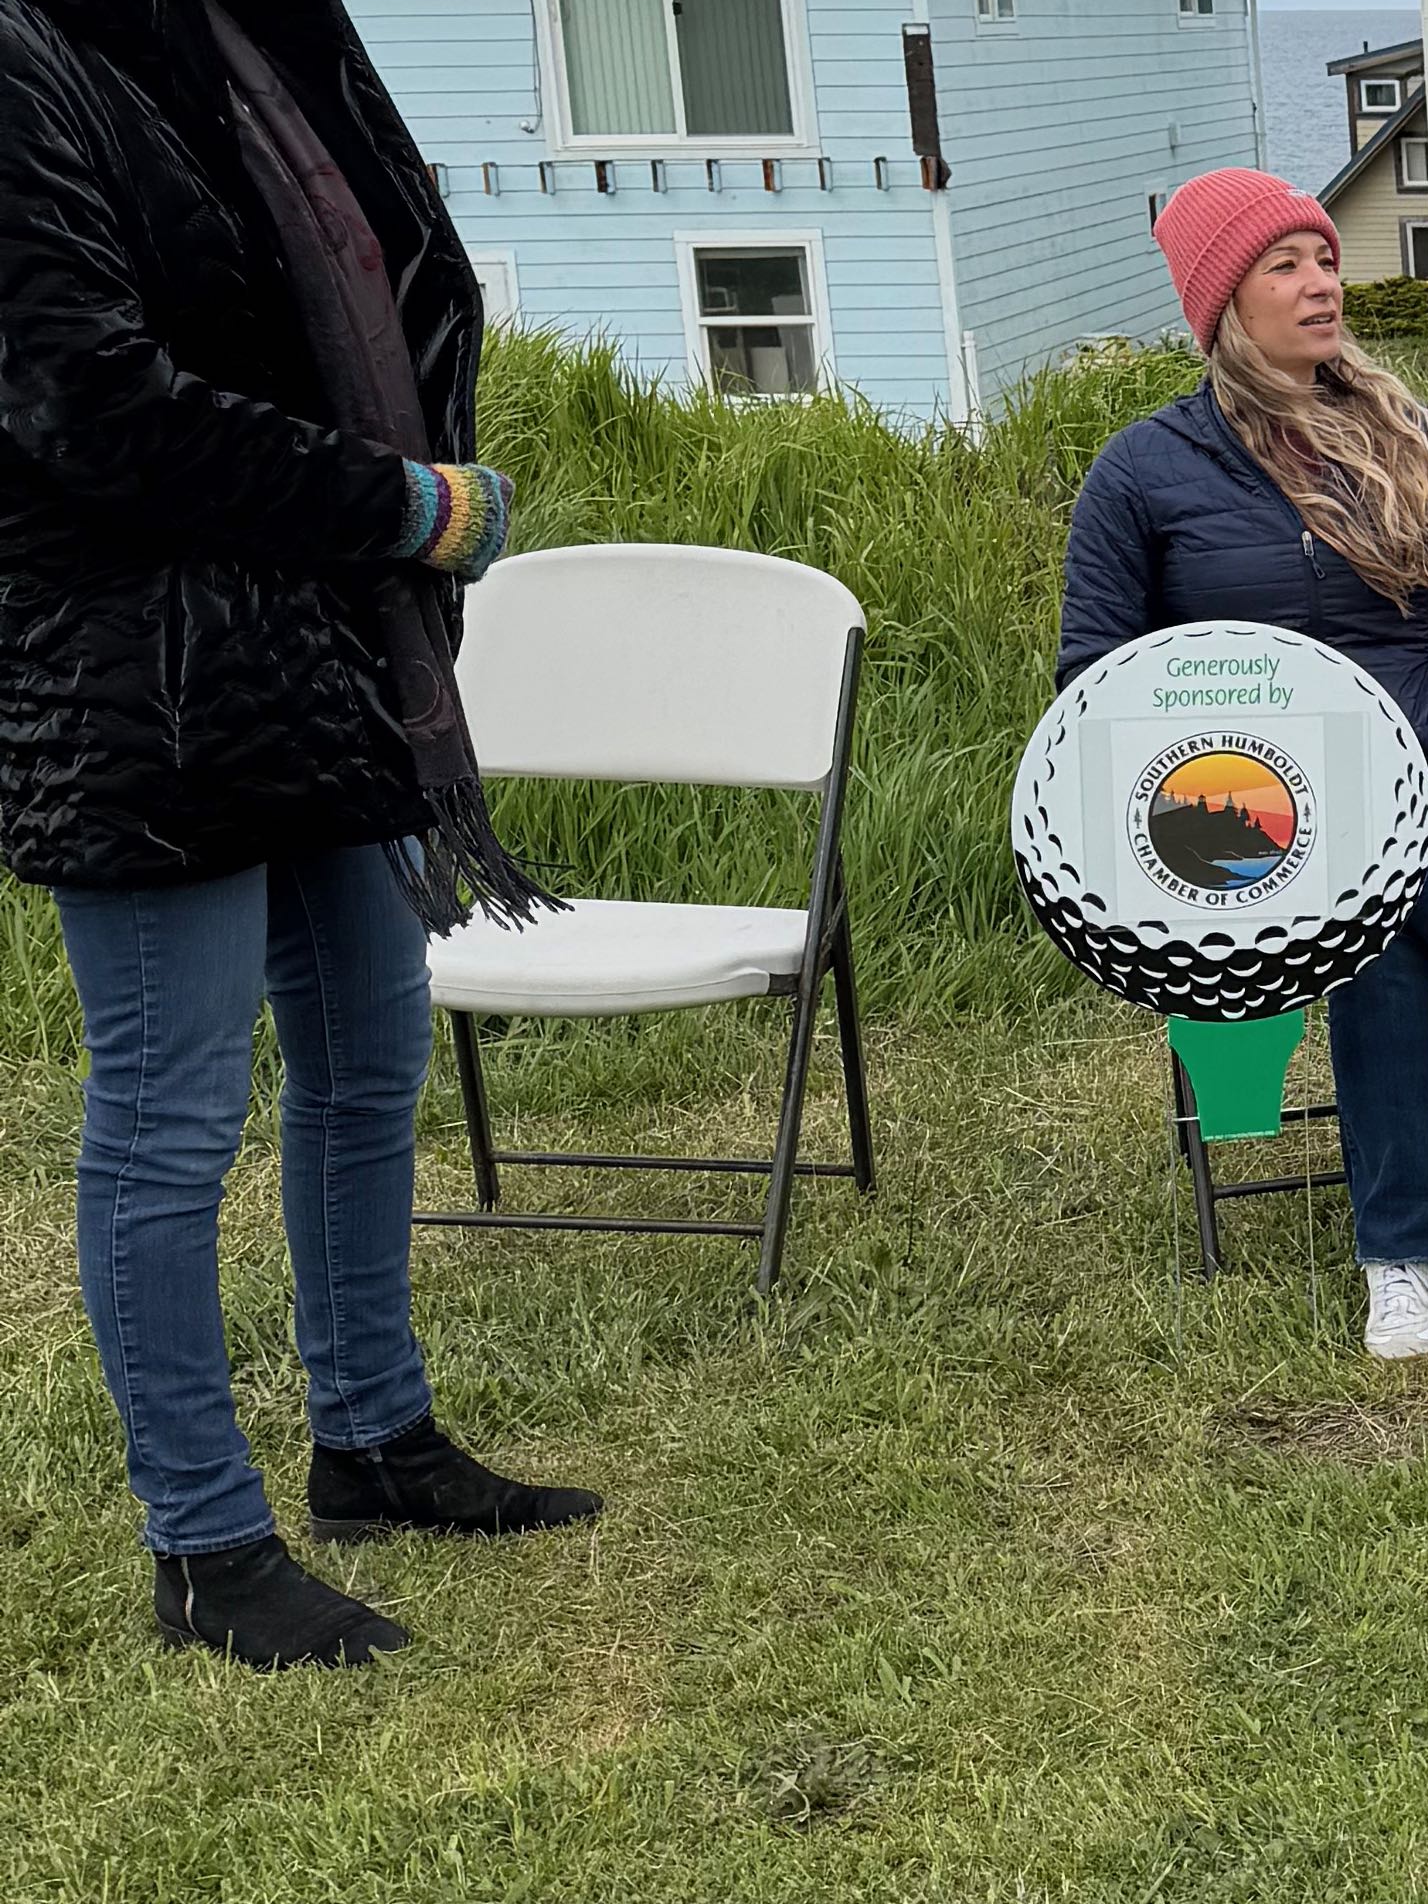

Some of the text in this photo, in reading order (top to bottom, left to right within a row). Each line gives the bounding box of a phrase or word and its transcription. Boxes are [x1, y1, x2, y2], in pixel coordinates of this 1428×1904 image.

[1167, 654, 1280, 680] Generously
[1153, 682, 1293, 712] Sponsored by
[1135, 735, 1309, 802] SOUTHERN HUMBOLDT
[1134, 826, 1312, 906] CHAMBER OF COMMERCE
